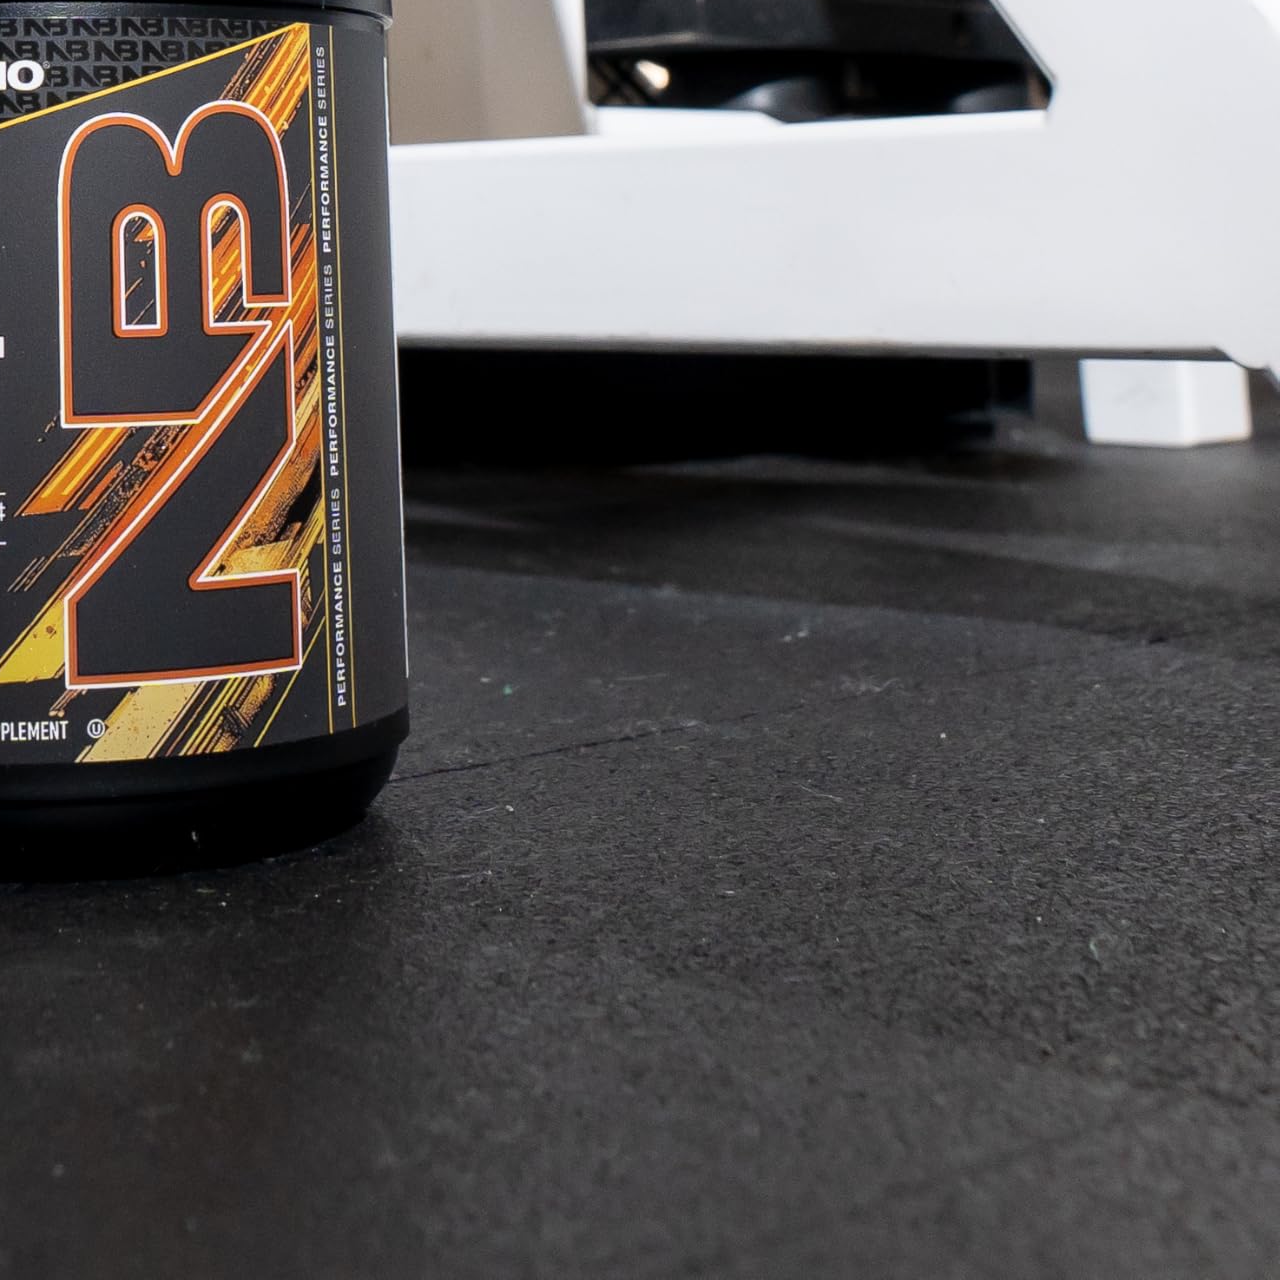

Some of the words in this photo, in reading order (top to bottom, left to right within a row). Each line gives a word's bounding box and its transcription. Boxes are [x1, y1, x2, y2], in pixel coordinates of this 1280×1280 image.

[316, 46, 327, 109] SERIES
[318, 115, 332, 253] PERFORMANCE
[323, 263, 335, 329] SERIES
[325, 334, 339, 476] PERFORMANCE
[330, 487, 342, 555] SERIES
[332, 560, 347, 707] PERFORMANCE
